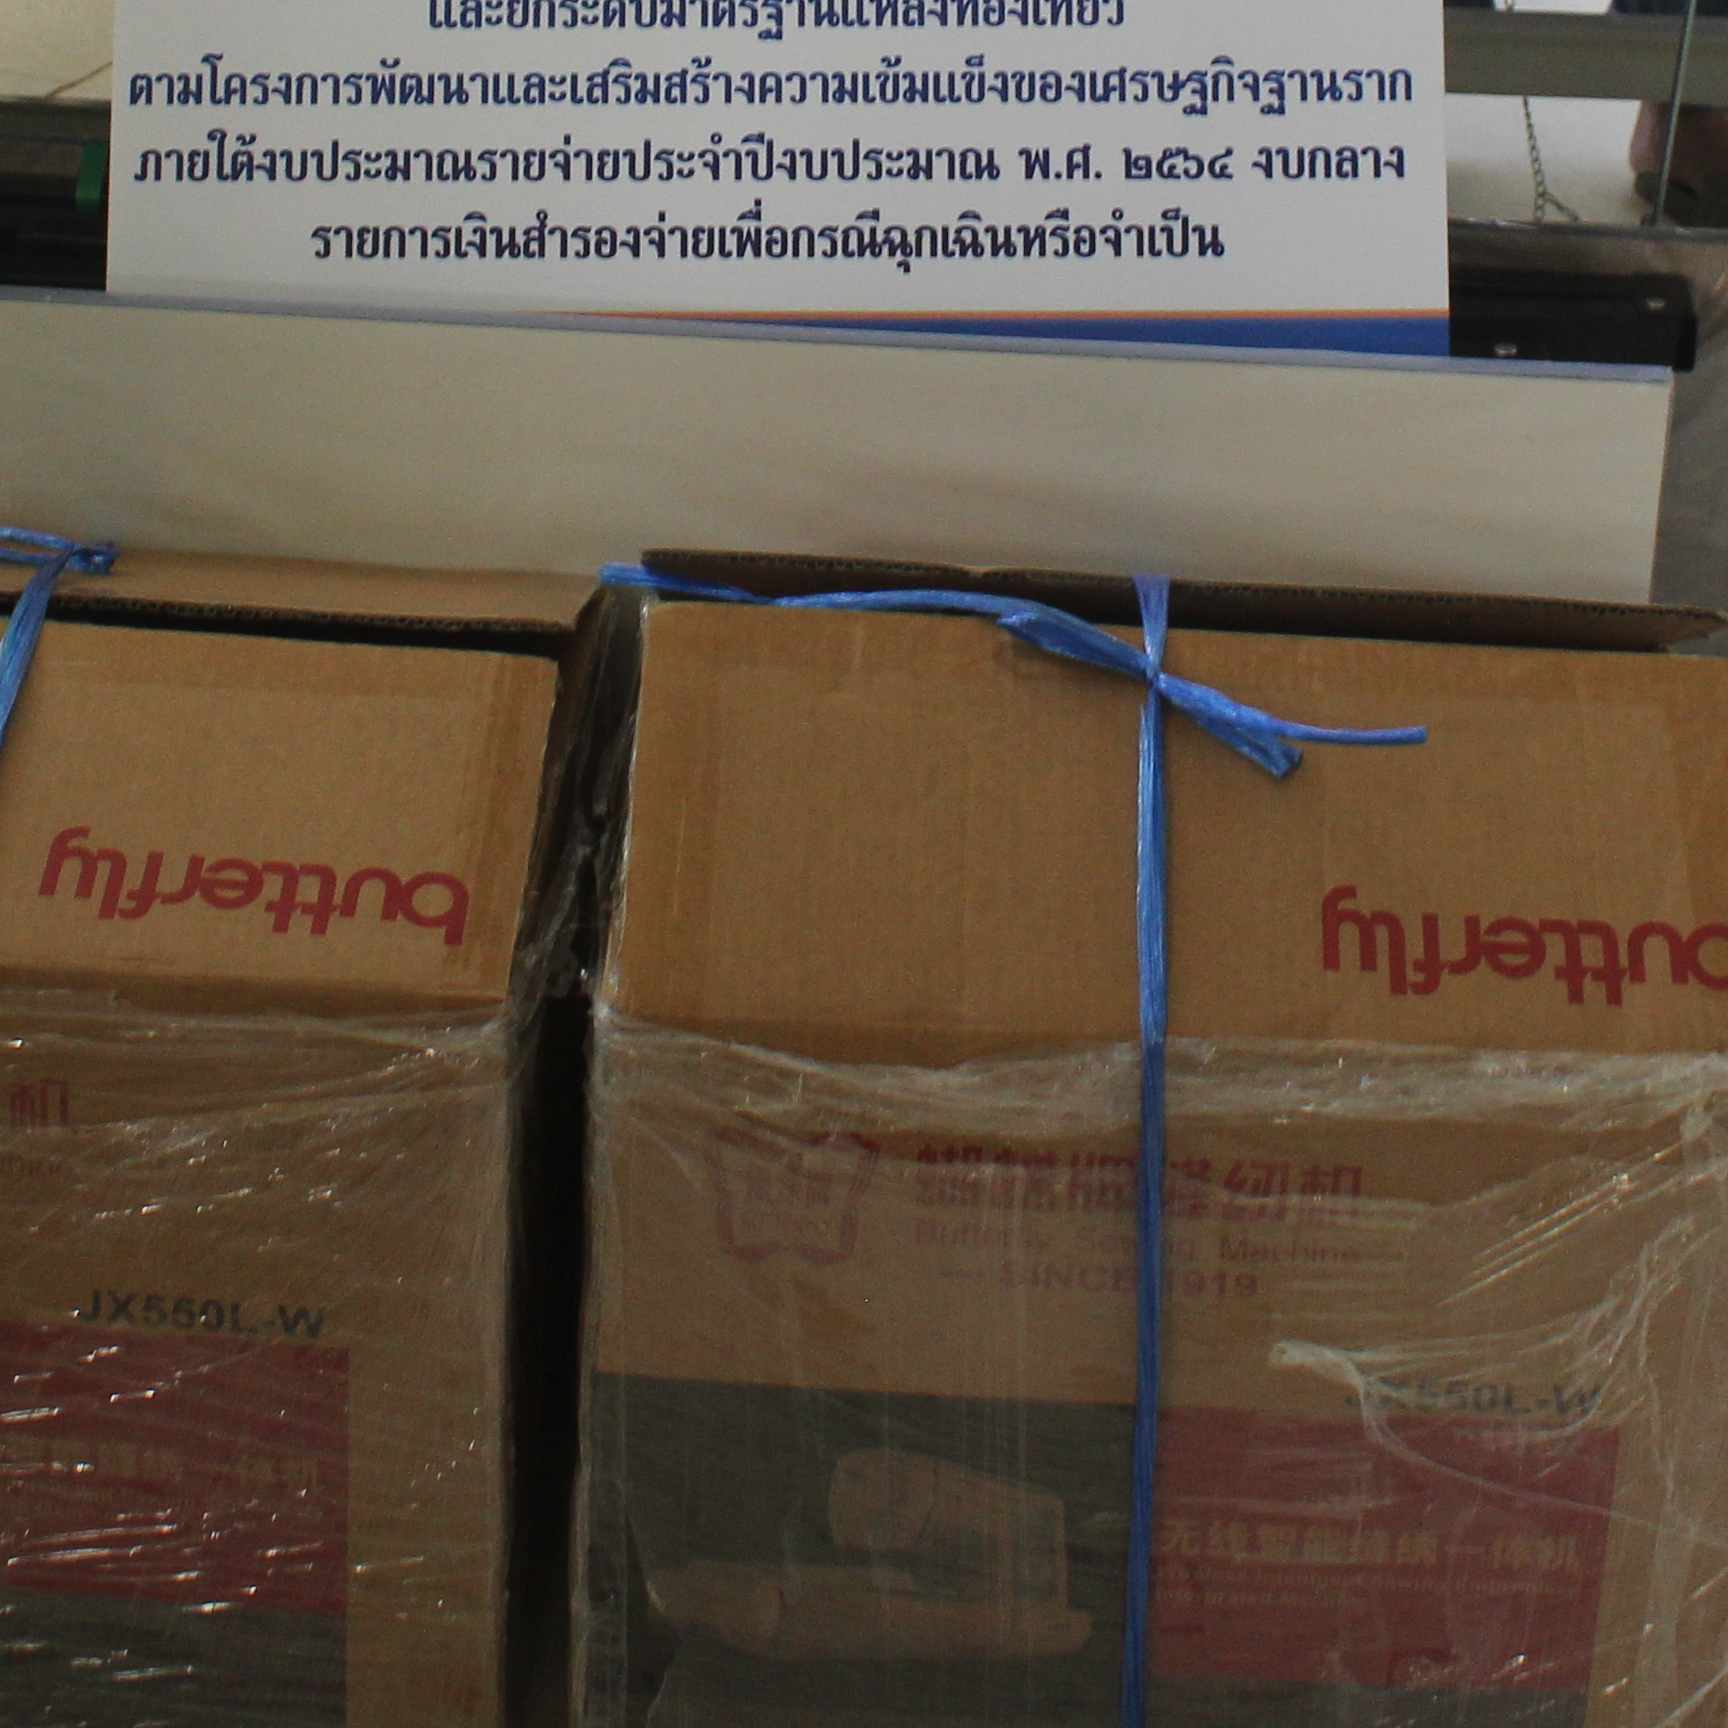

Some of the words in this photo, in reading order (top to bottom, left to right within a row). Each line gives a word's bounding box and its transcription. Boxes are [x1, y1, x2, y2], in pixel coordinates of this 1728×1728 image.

[129, 54, 1413, 115] ตามโครงการพัฒนาและเสริมสร้างความเข้มแข็งของเศรษฐกิจฐานราก
[134, 129, 1001, 183] ภายใต้งบประมาณรายจ่ายประจำปีงบประมาณ
[1018, 142, 1103, 180] พ.ศ.
[1123, 146, 1234, 180] ๒๕๖๔
[1252, 145, 1405, 180] งบกลาง
[311, 199, 1225, 273] รายการเงินสำรองจ่ายเพื่อกรณีฉุกเฉินหรือจำเป็น
[38, 826, 470, 946] butterfly
[79, 1289, 327, 1338] JX550L-W
